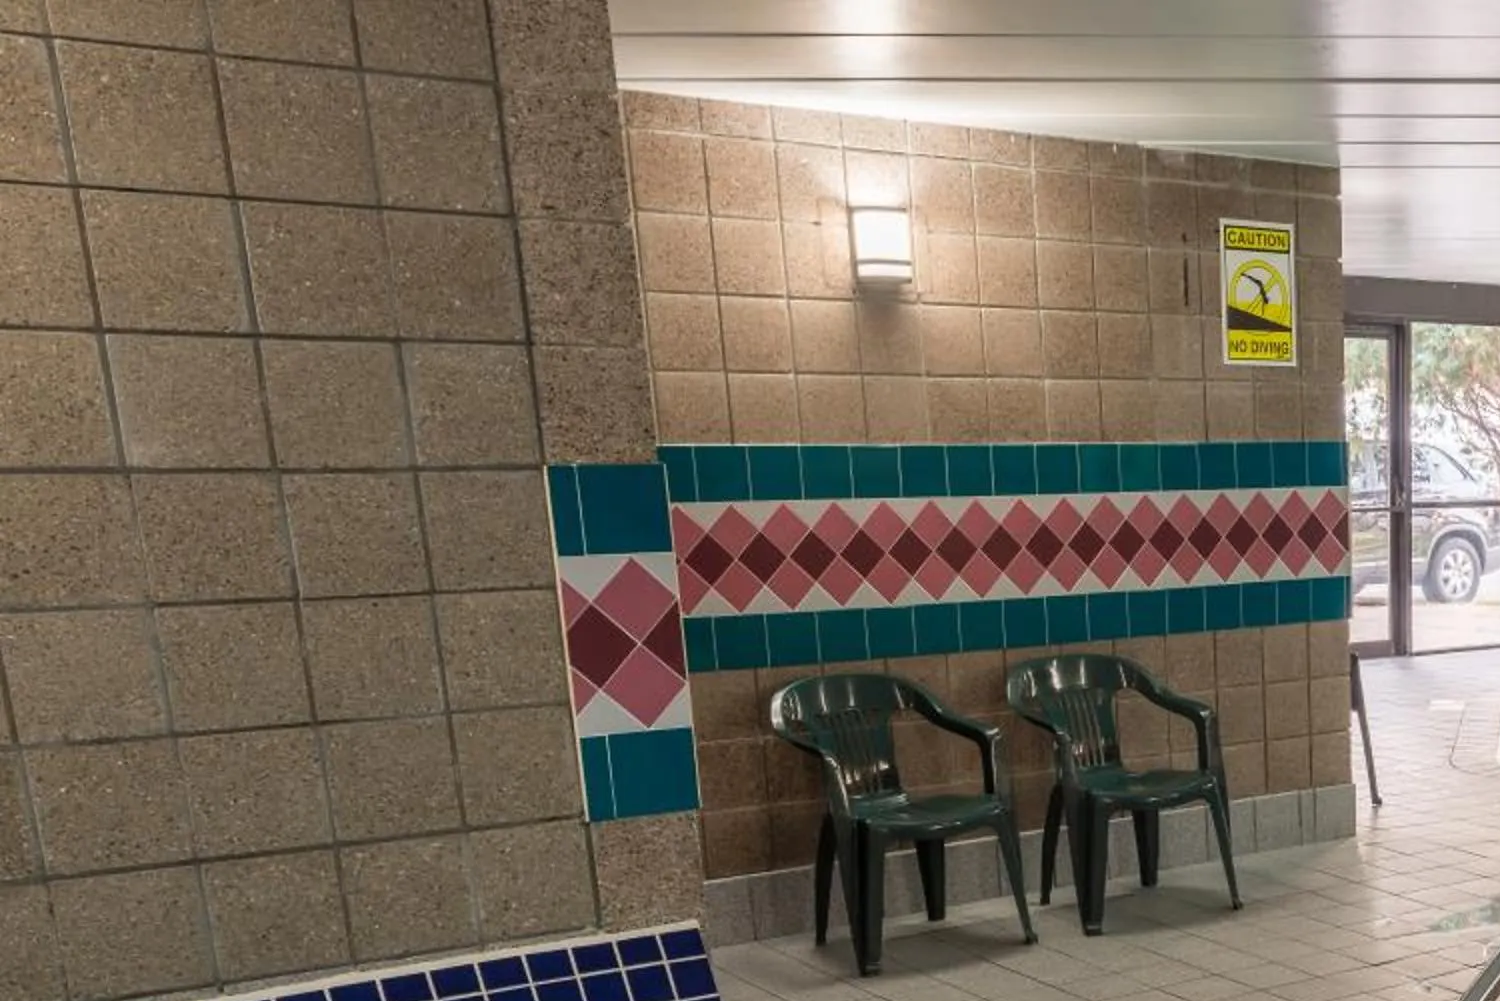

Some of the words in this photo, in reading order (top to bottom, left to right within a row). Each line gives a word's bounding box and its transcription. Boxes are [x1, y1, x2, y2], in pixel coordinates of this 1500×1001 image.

[1228, 230, 1286, 248] CAUTION
[1231, 340, 1247, 353] NO
[1251, 341, 1289, 355] DIVING
